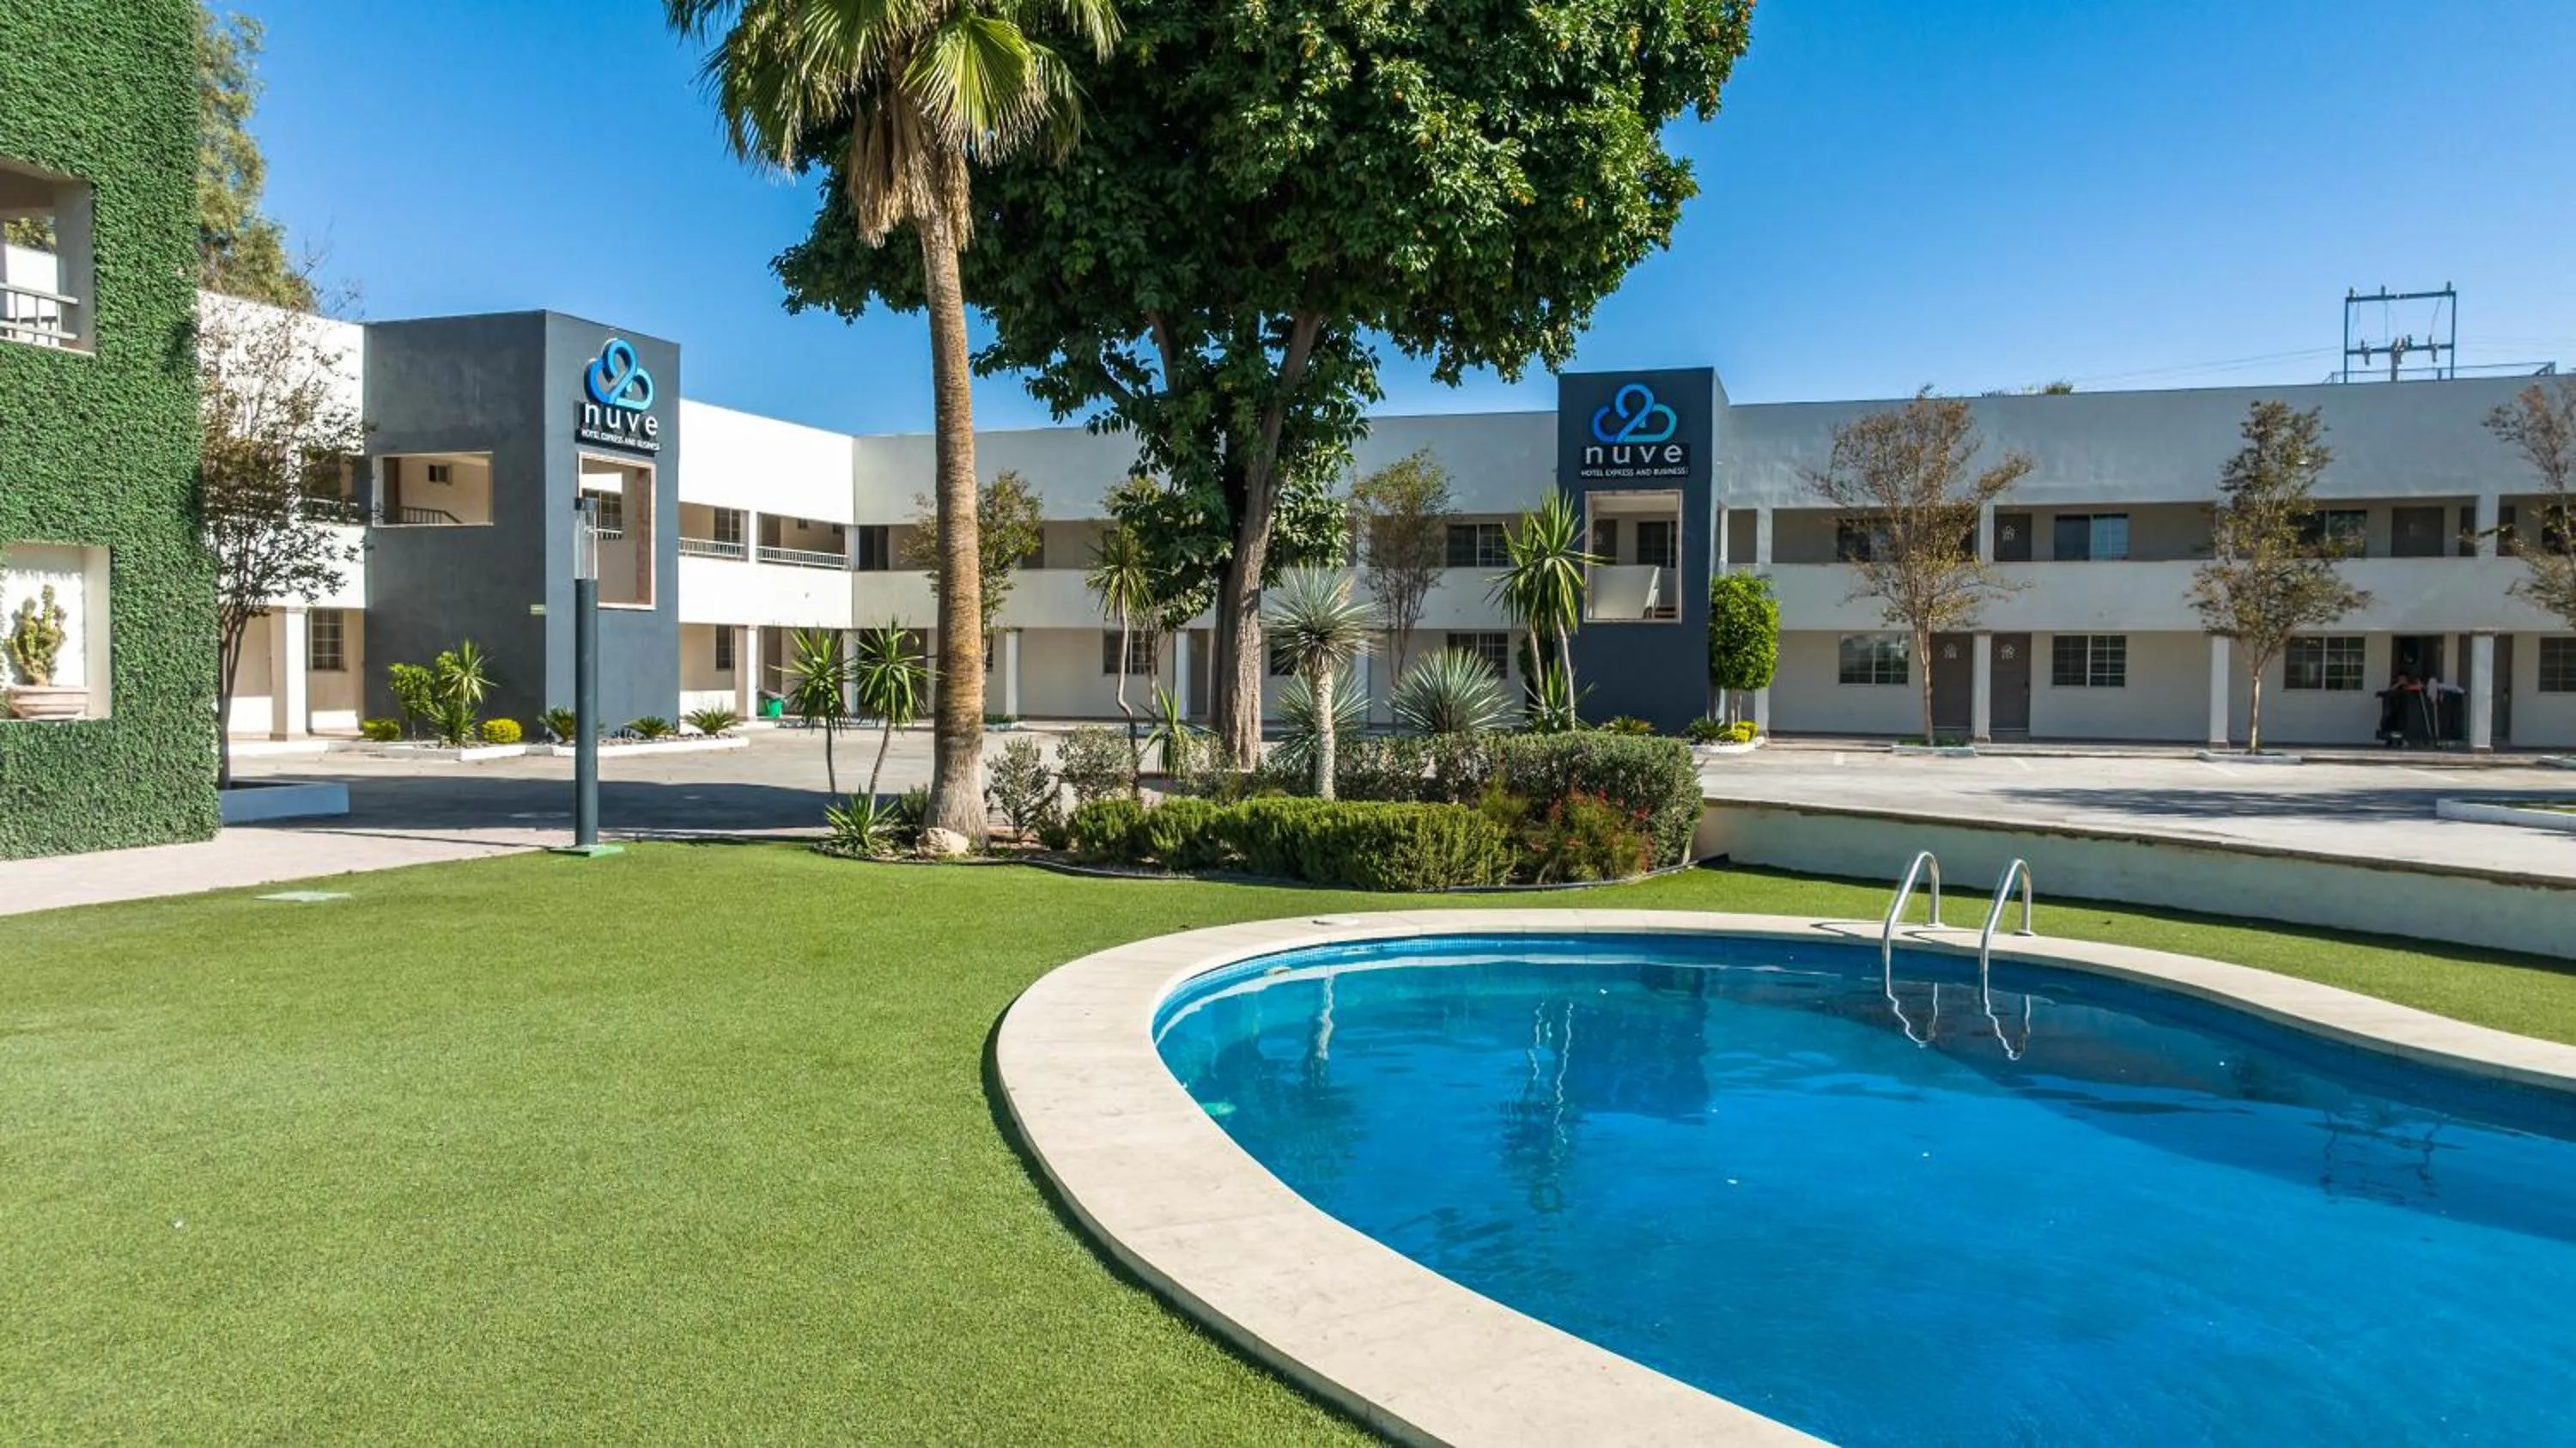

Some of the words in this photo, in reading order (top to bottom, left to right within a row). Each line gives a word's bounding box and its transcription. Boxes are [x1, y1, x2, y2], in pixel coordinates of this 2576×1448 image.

[585, 403, 659, 435] nuve
[1585, 444, 1683, 465] nuve
[1581, 468, 1603, 477] HOTEL
[1605, 468, 1634, 477] EXPRESS
[1636, 468, 1652, 477] AND
